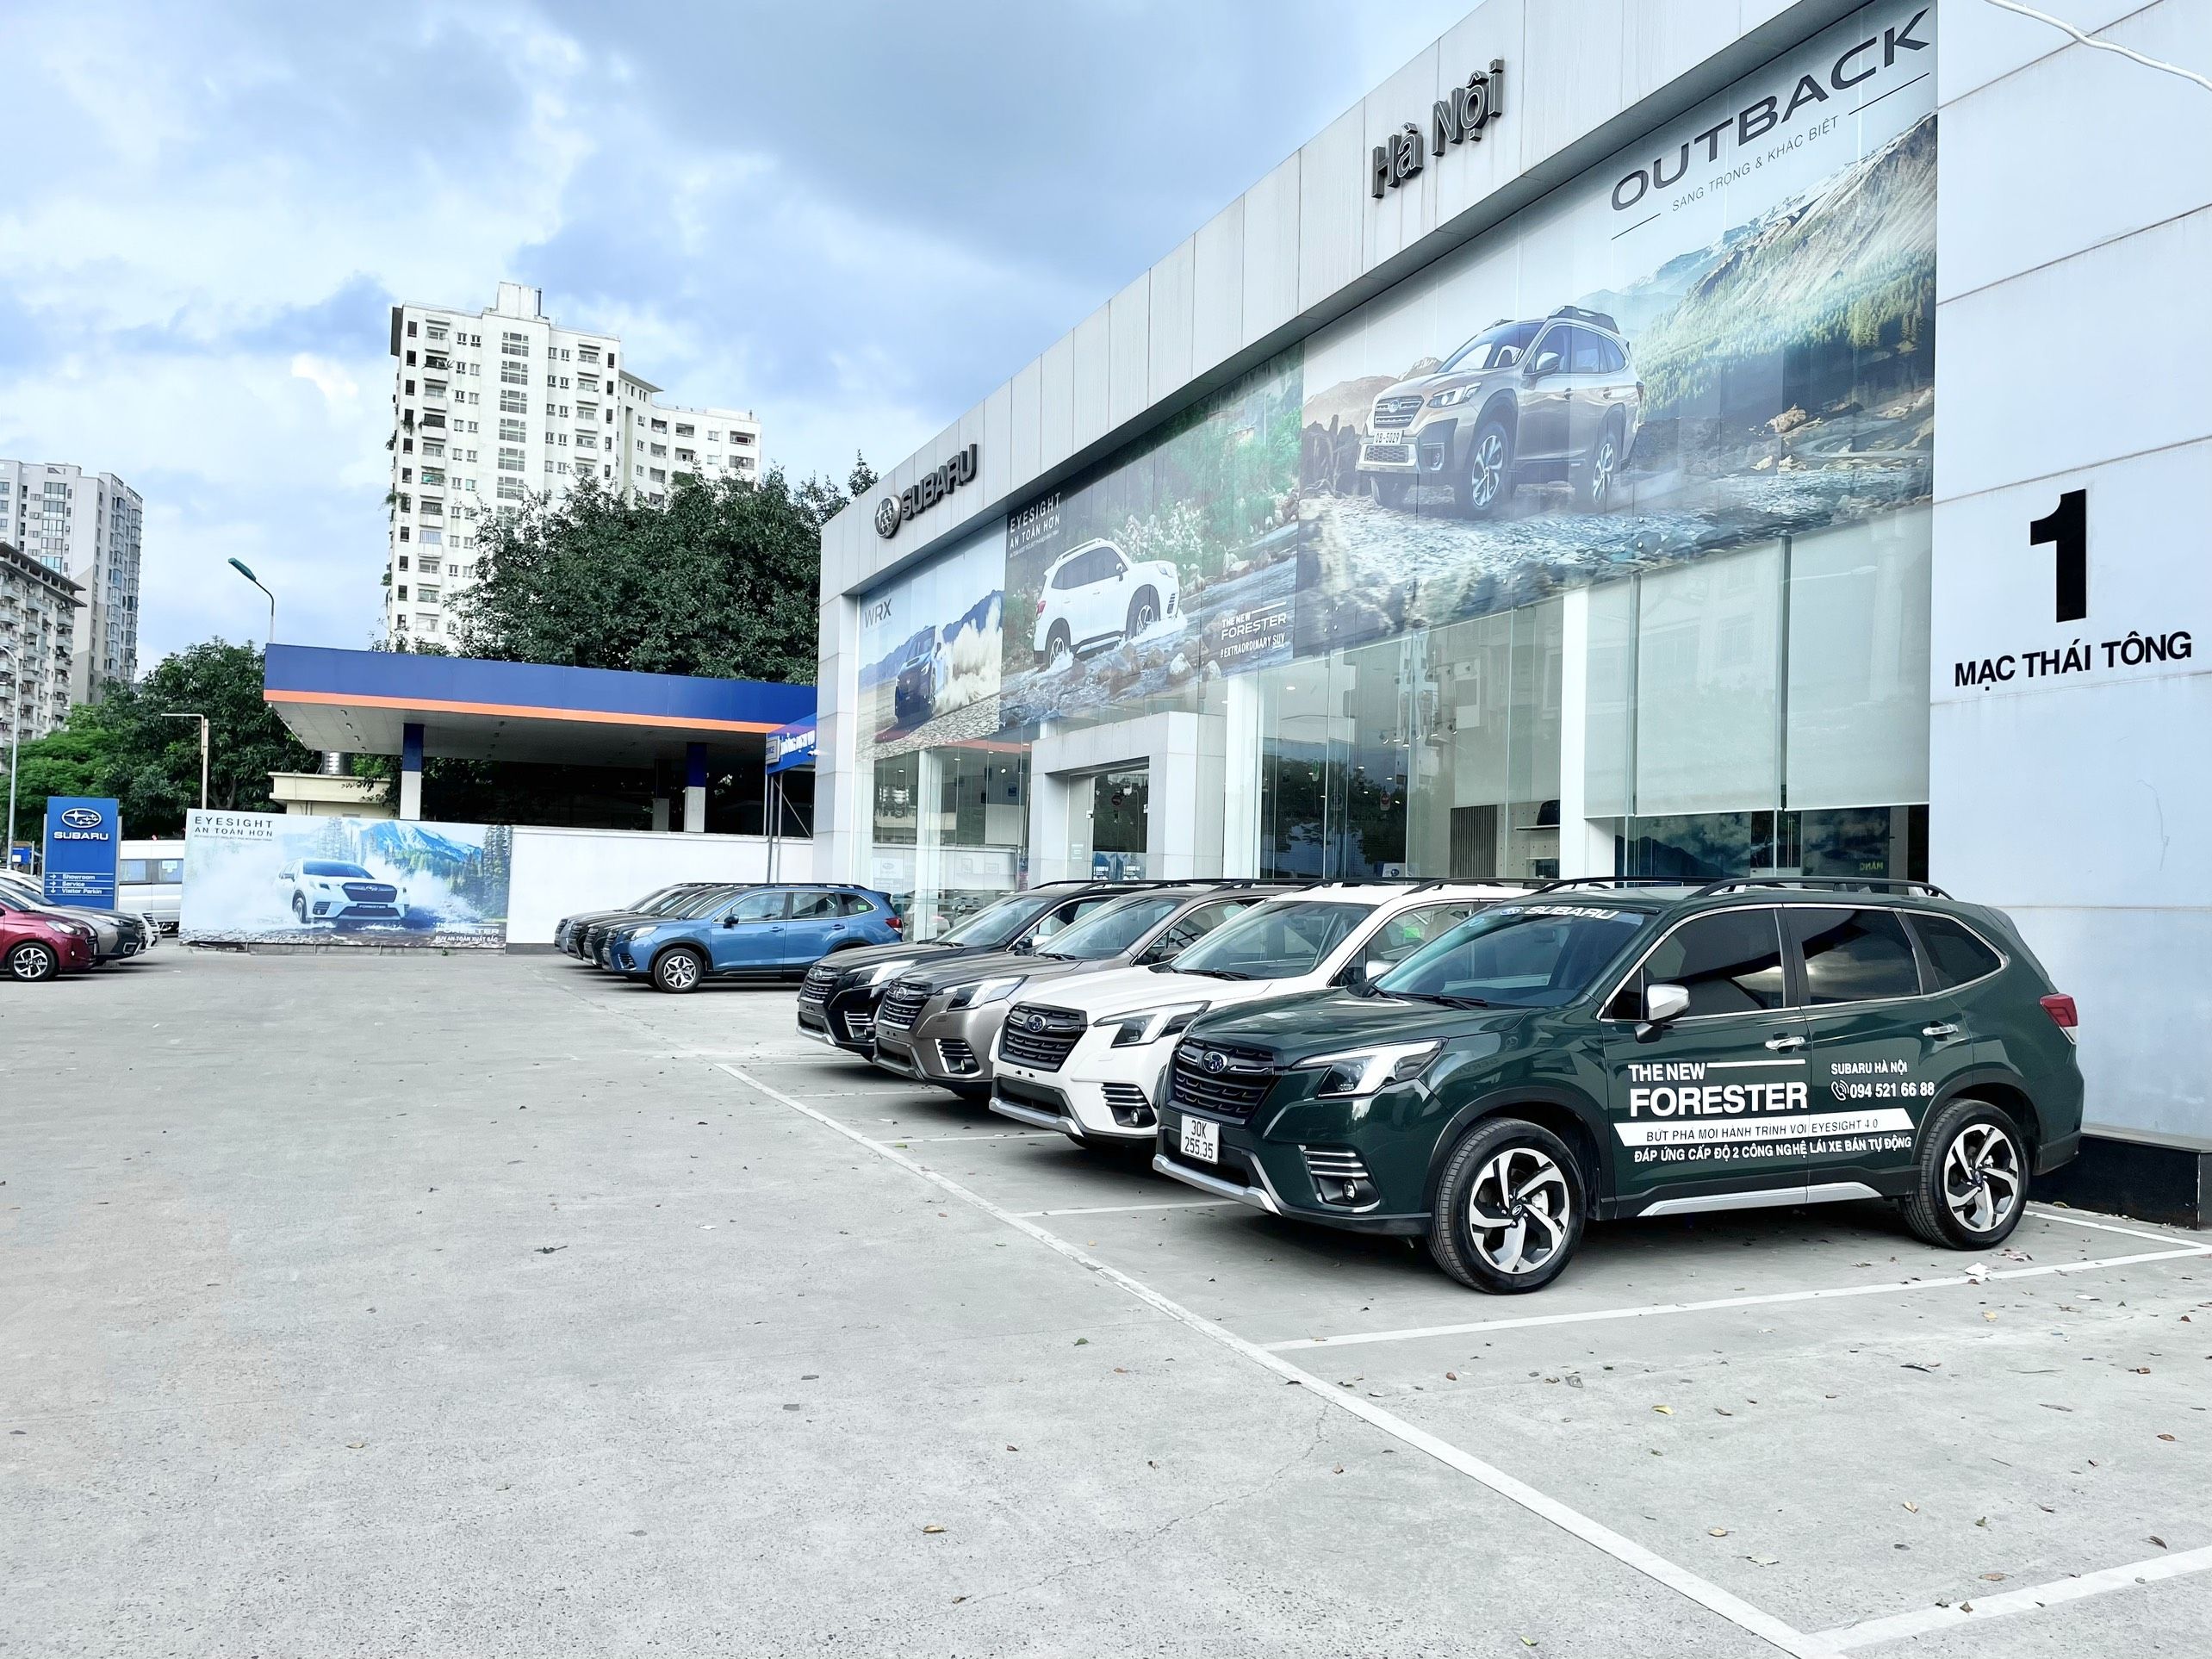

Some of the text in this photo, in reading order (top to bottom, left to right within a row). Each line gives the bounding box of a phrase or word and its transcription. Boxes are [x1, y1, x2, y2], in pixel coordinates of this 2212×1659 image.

[1612, 7, 1930, 212] OUTBACK
[1371, 59, 1503, 199] Hà Nội
[1672, 115, 1839, 212] SANG TRỌNG & KHÁC BIỆT
[901, 444, 978, 521] SUBARU
[1010, 492, 1060, 533] EYESIGHT
[1010, 535, 1019, 550] AN
[1022, 524, 1041, 543] TOÀN
[2030, 488, 2087, 624] 1
[865, 598, 892, 628] WRX
[1221, 612, 1252, 628] THE NEW
[1221, 612, 1287, 641] FORESTER
[1272, 632, 1285, 645] SUV
[1954, 631, 2192, 691] MẠC THÁI TÔNG
[195, 816, 273, 828] EYESIGHT
[53, 831, 109, 841] SUBARU
[1525, 905, 1620, 920] SUBARU
[1627, 1062, 1706, 1082] THE NEW
[1830, 1059, 1908, 1075] SUBARU HÀ NỘI
[1630, 1081, 1808, 1117] FORESTER
[1849, 1081, 1936, 1098] 094 521 66 88
[1191, 1120, 1207, 1139] 30K
[1811, 1120, 1861, 1134] EYESIGHT
[1864, 1118, 1879, 1128] 4.0
[1184, 1136, 1214, 1159] 255.35
[1634, 1134, 1911, 1163] ĐÁP ỨNG CẤP ĐỘ 2 CÔNG NGHỆ LÁI XE BÁN TỰ ĐỘNG
